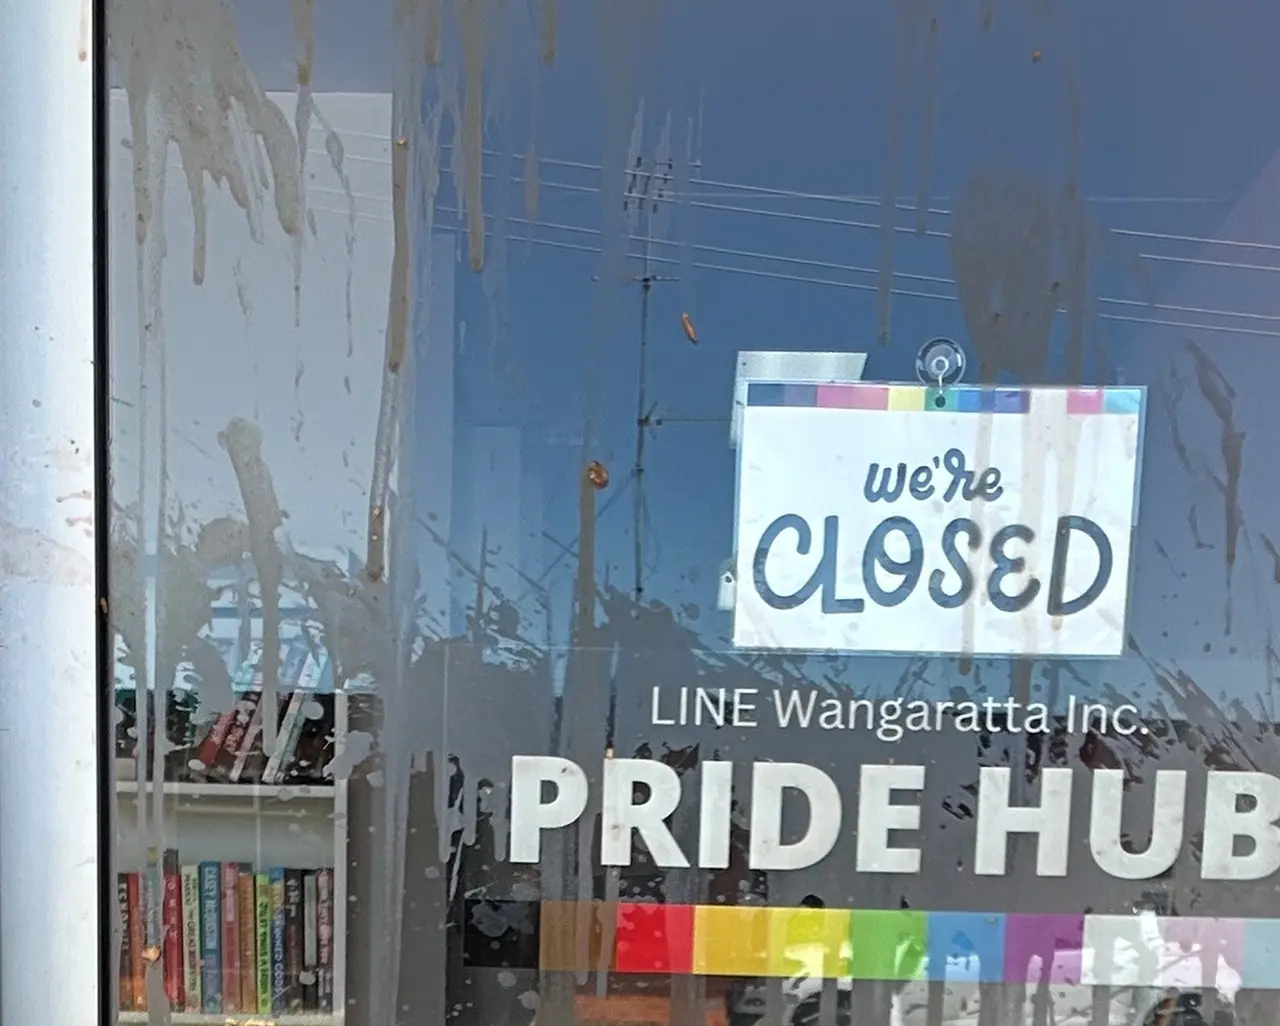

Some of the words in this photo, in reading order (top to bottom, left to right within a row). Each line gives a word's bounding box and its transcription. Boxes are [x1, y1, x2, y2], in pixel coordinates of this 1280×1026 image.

[864, 448, 1003, 502] we're
[753, 513, 1113, 616] CLOSED
[651, 687, 758, 728] LINE
[774, 690, 1049, 742] Wangaratta
[1067, 695, 1150, 735] Inc.
[509, 755, 925, 875] PRIDE
